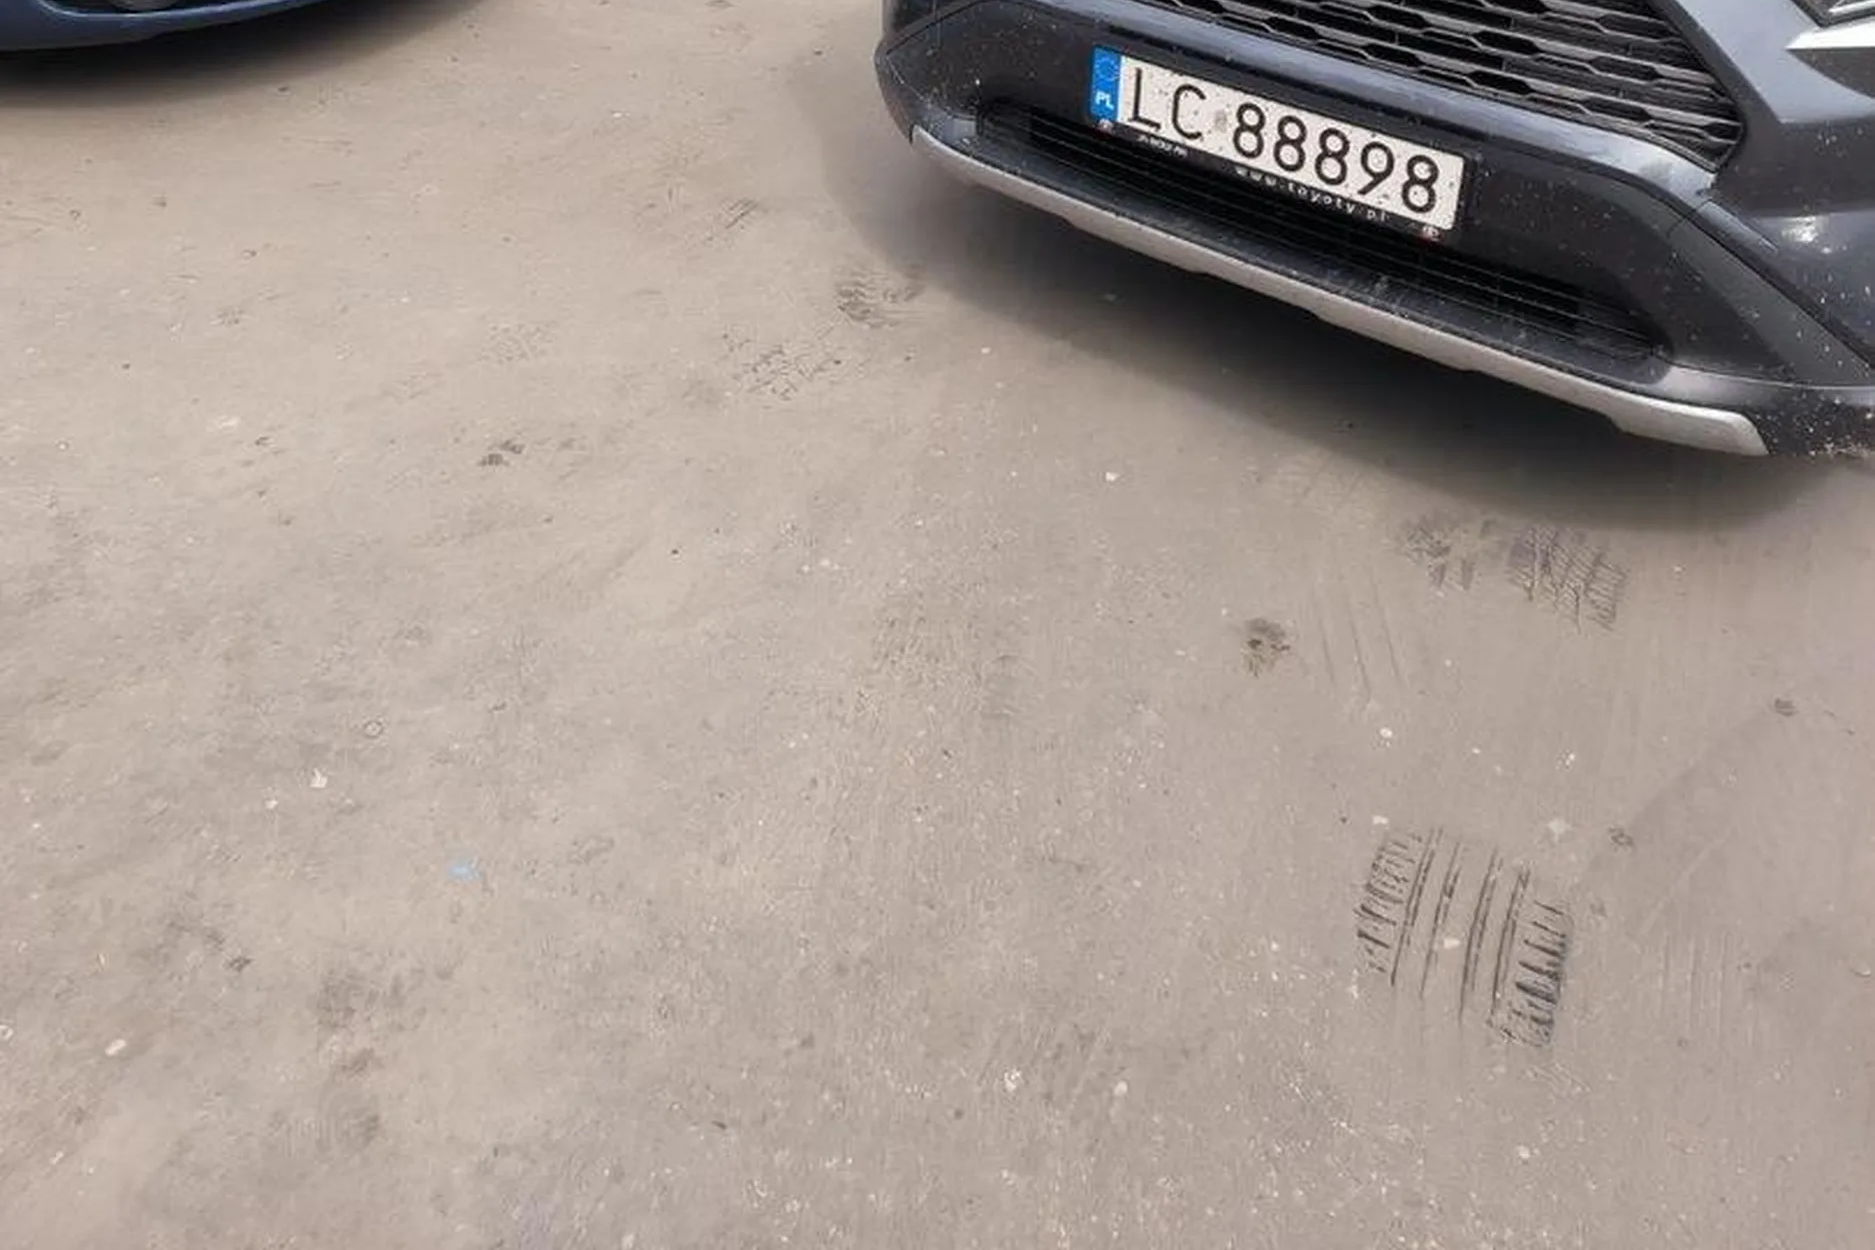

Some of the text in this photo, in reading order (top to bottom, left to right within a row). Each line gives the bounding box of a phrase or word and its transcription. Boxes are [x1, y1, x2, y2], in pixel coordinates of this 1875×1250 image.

[1095, 89, 1115, 110] PL
[1127, 66, 1440, 214] LC 88898
